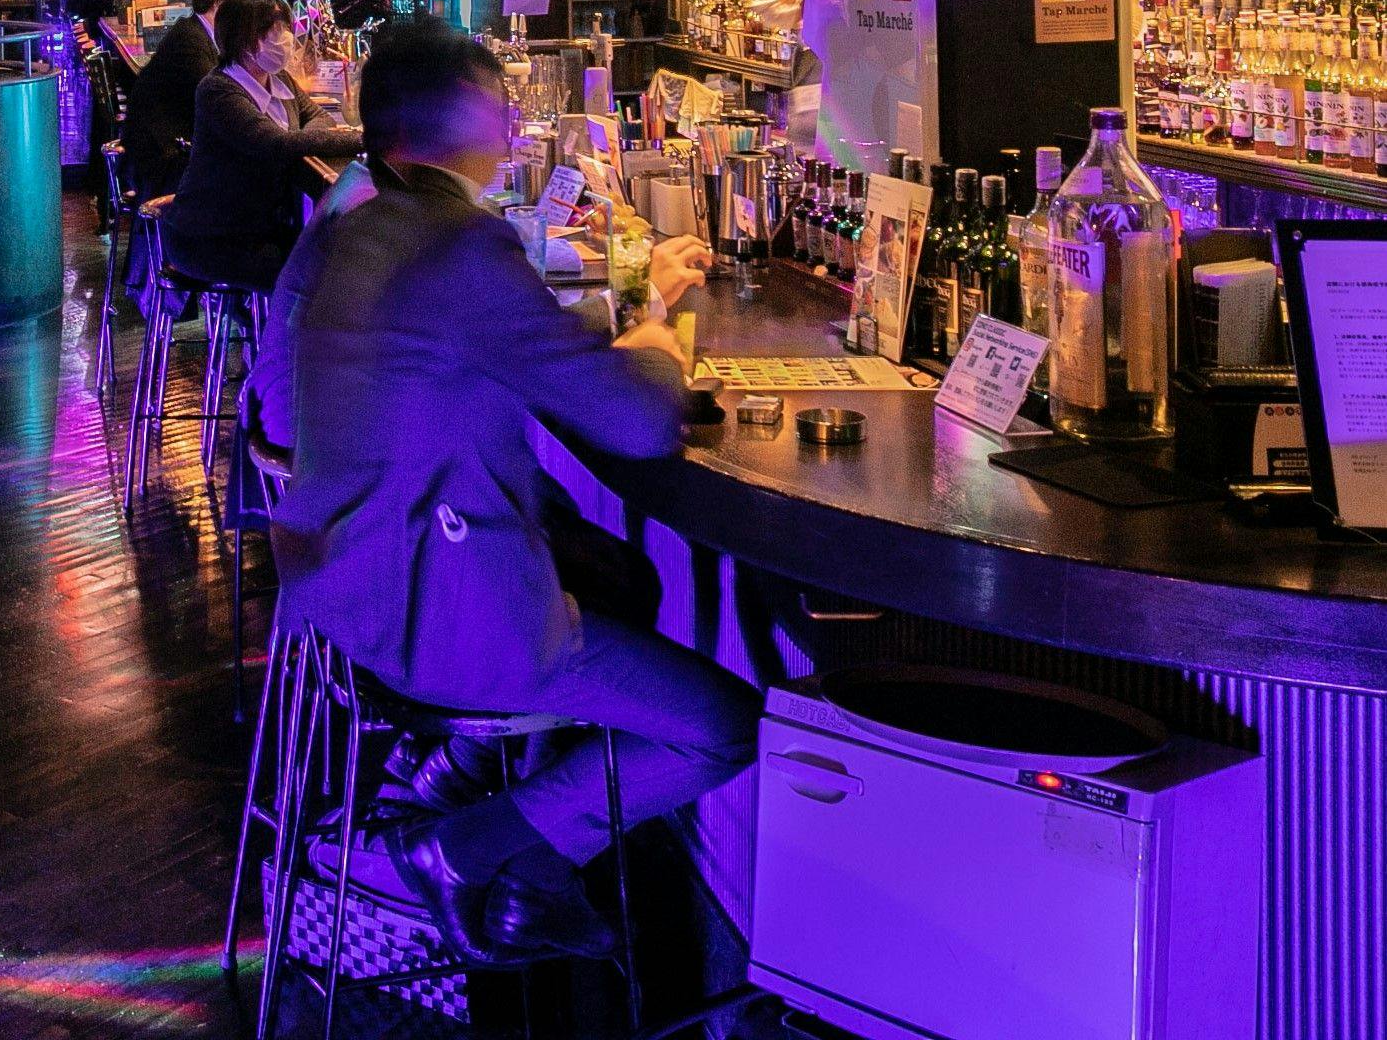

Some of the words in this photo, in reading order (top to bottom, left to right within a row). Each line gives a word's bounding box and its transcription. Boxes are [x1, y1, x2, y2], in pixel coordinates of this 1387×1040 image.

[1042, 7, 1063, 18] Tap
[1066, 4, 1108, 15] Marché
[857, 10, 874, 32] Tap
[876, 10, 914, 31] Marché
